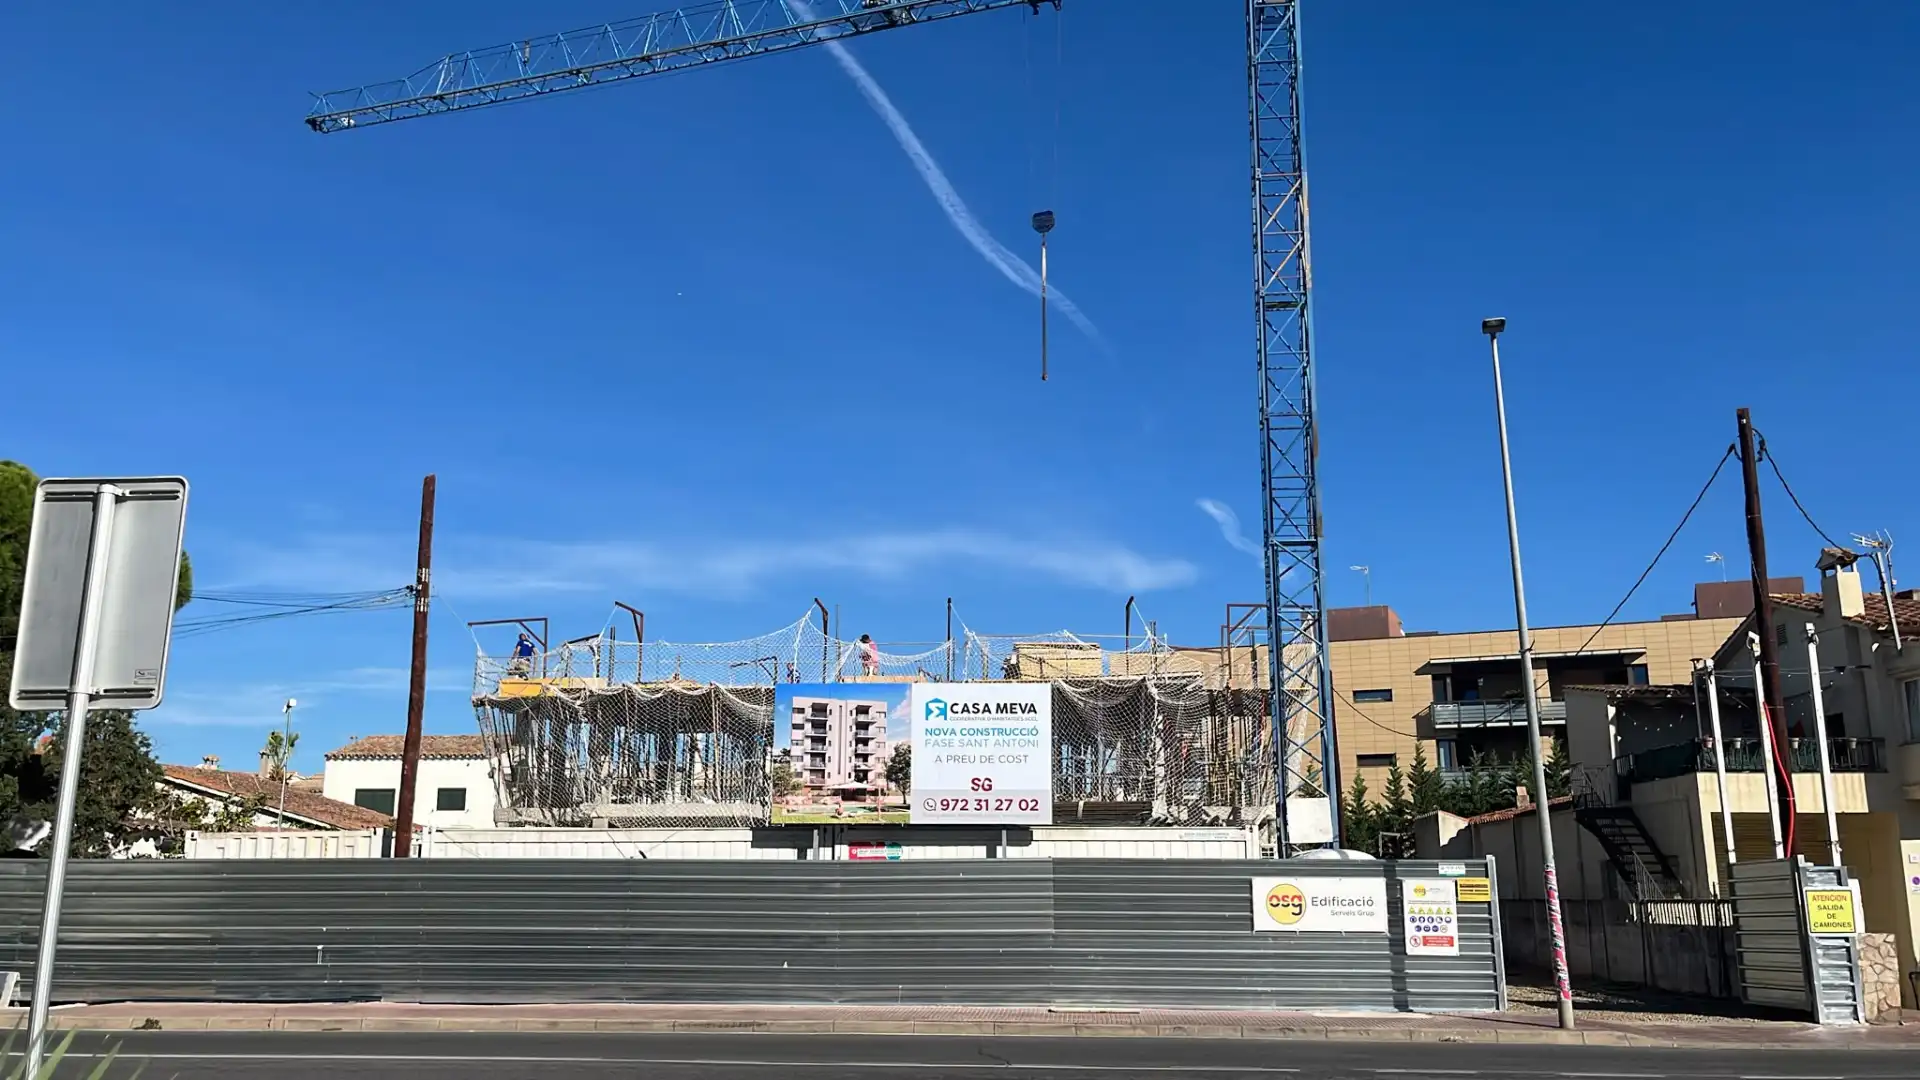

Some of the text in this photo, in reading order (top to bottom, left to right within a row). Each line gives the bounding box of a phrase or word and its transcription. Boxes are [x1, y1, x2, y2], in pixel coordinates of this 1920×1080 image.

[950, 702, 1038, 715] CASA MEVA
[925, 725, 1039, 737] NOVA CONSTRUCCIÓ
[925, 738, 1039, 748] FASE SANT ANTONI
[935, 754, 1029, 764] A PREU DE COST
[970, 777, 993, 792] SG
[940, 798, 1039, 811] 972 31 27 02
[1268, 894, 1303, 916] osg
[1311, 896, 1375, 907] Edificació
[1357, 909, 1375, 917] Grup
